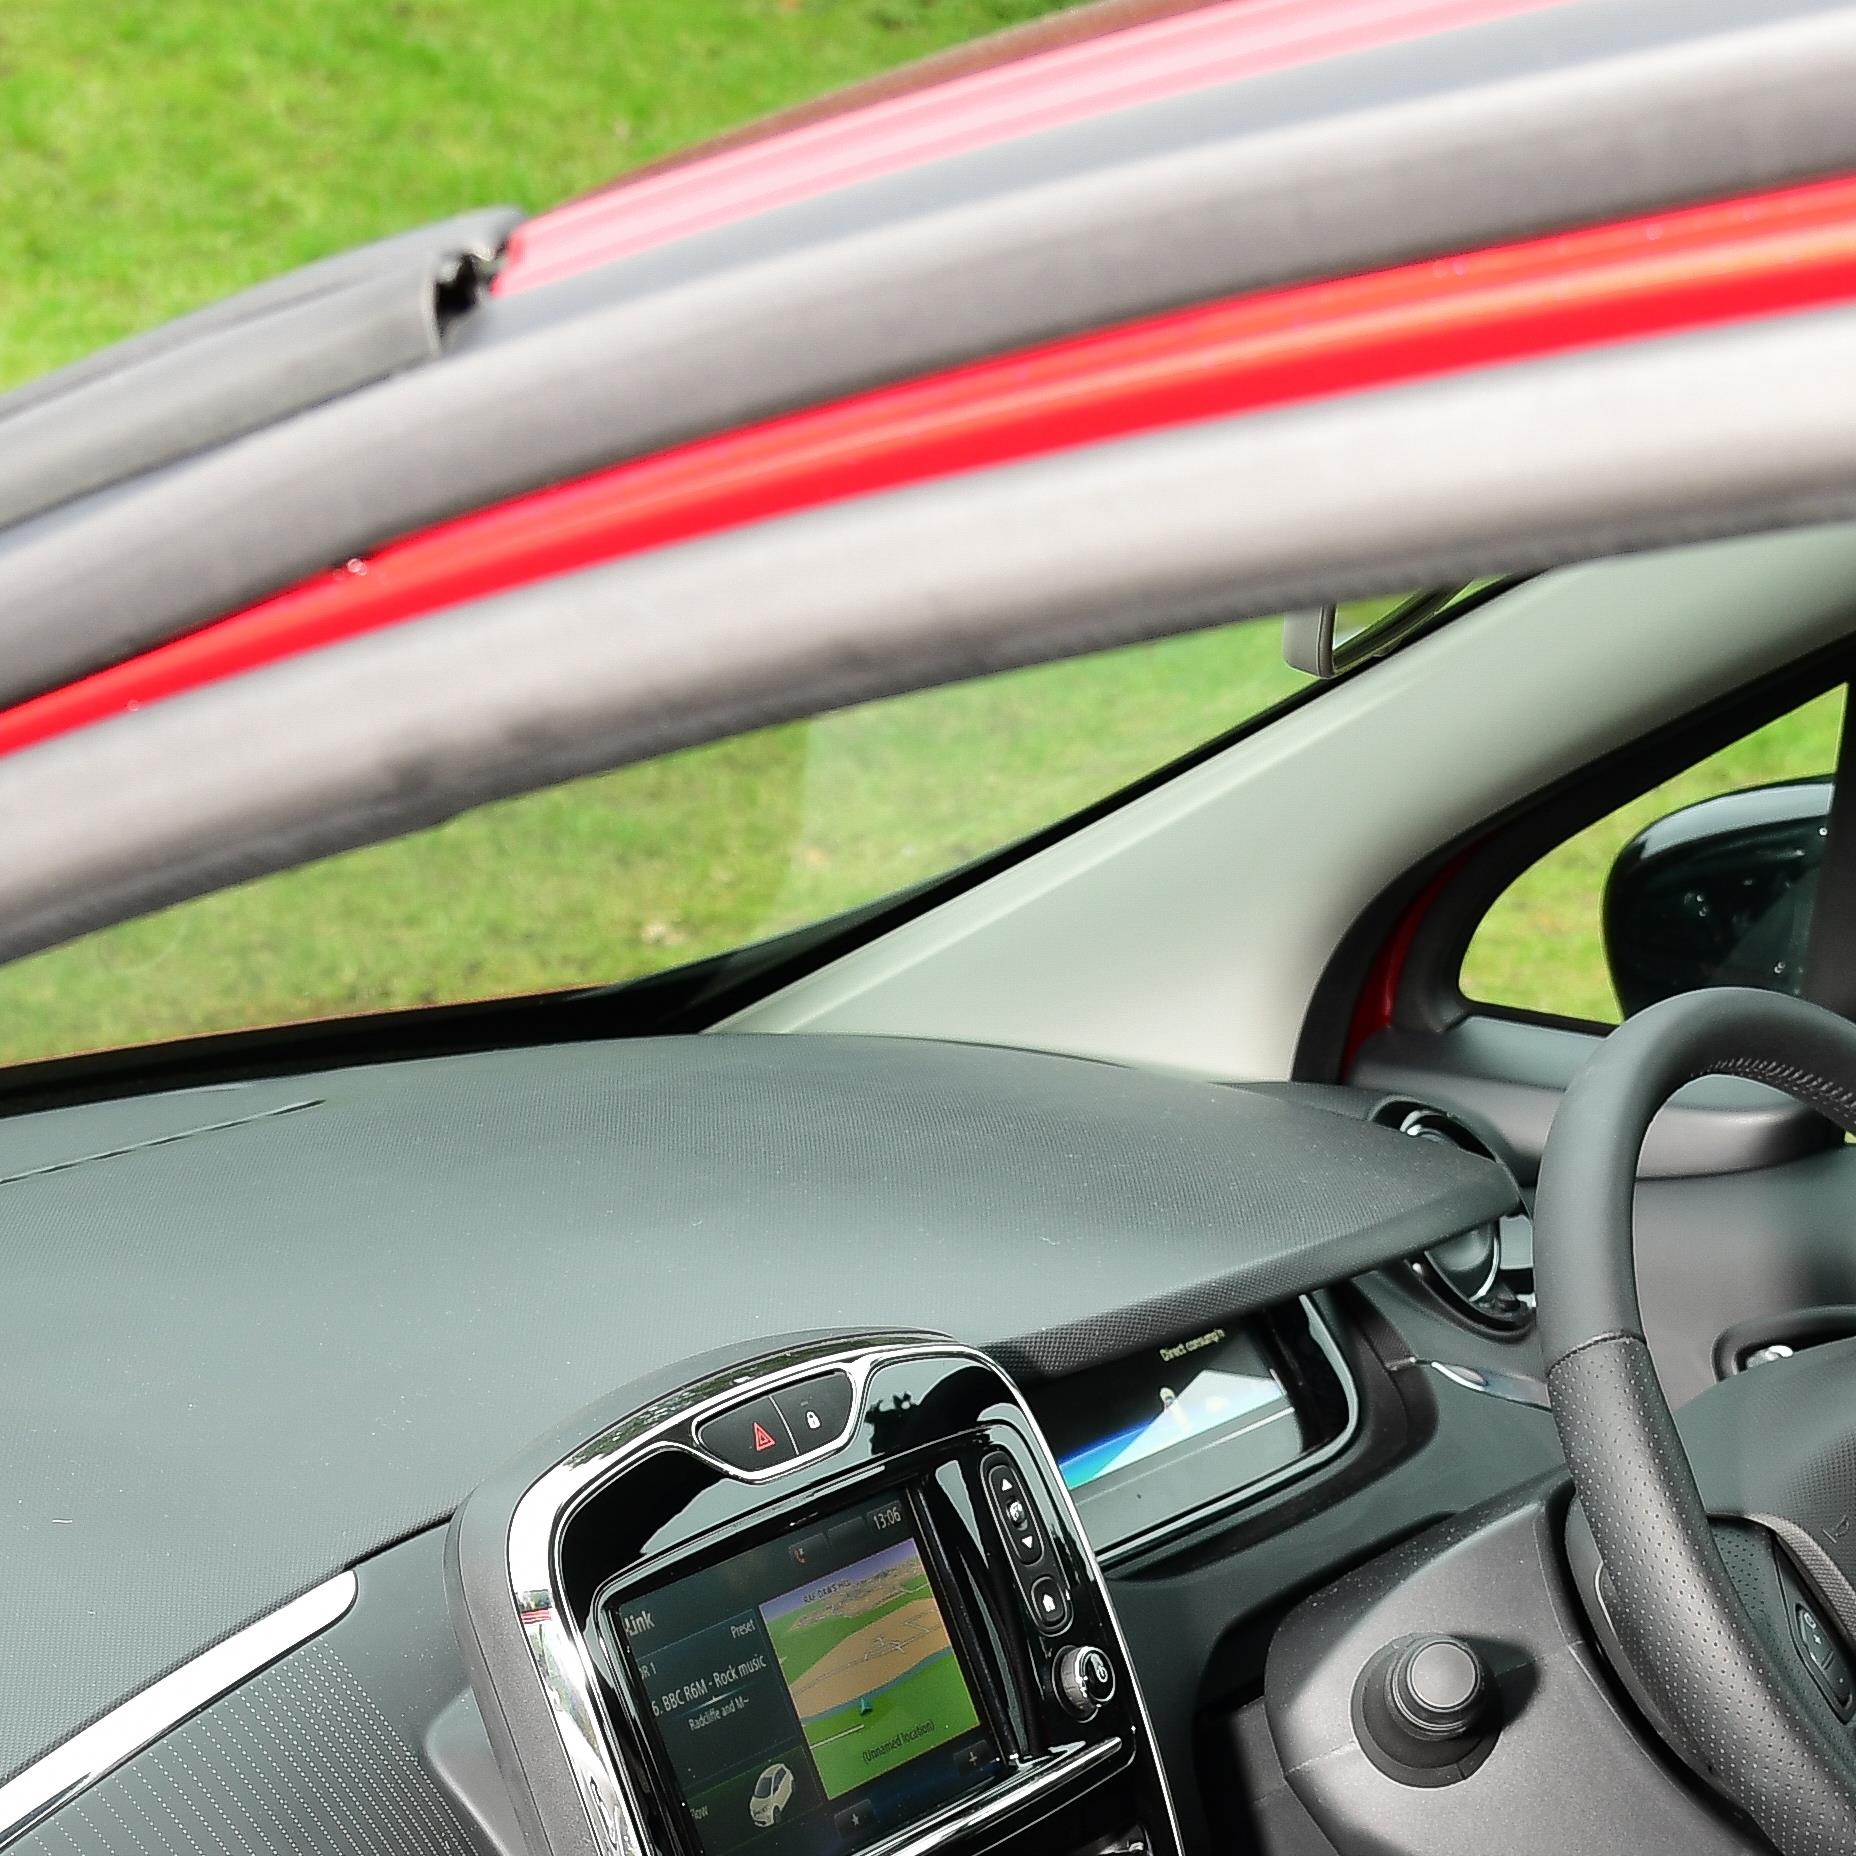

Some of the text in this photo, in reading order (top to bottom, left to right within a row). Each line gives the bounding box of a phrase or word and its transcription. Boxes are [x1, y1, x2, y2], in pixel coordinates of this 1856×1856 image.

[873, 1506, 902, 1531] 13:06
[730, 1617, 757, 1639] Preset
[651, 1699, 664, 1717] 6.
[661, 1688, 686, 1712] BBC
[683, 1677, 709, 1702] R6M
[712, 1664, 739, 1689] Rock
[738, 1653, 767, 1677] music
[687, 1706, 722, 1731] Radcliffe
[721, 1700, 736, 1717] and
[861, 1719, 936, 1765] (Unnamed location)
